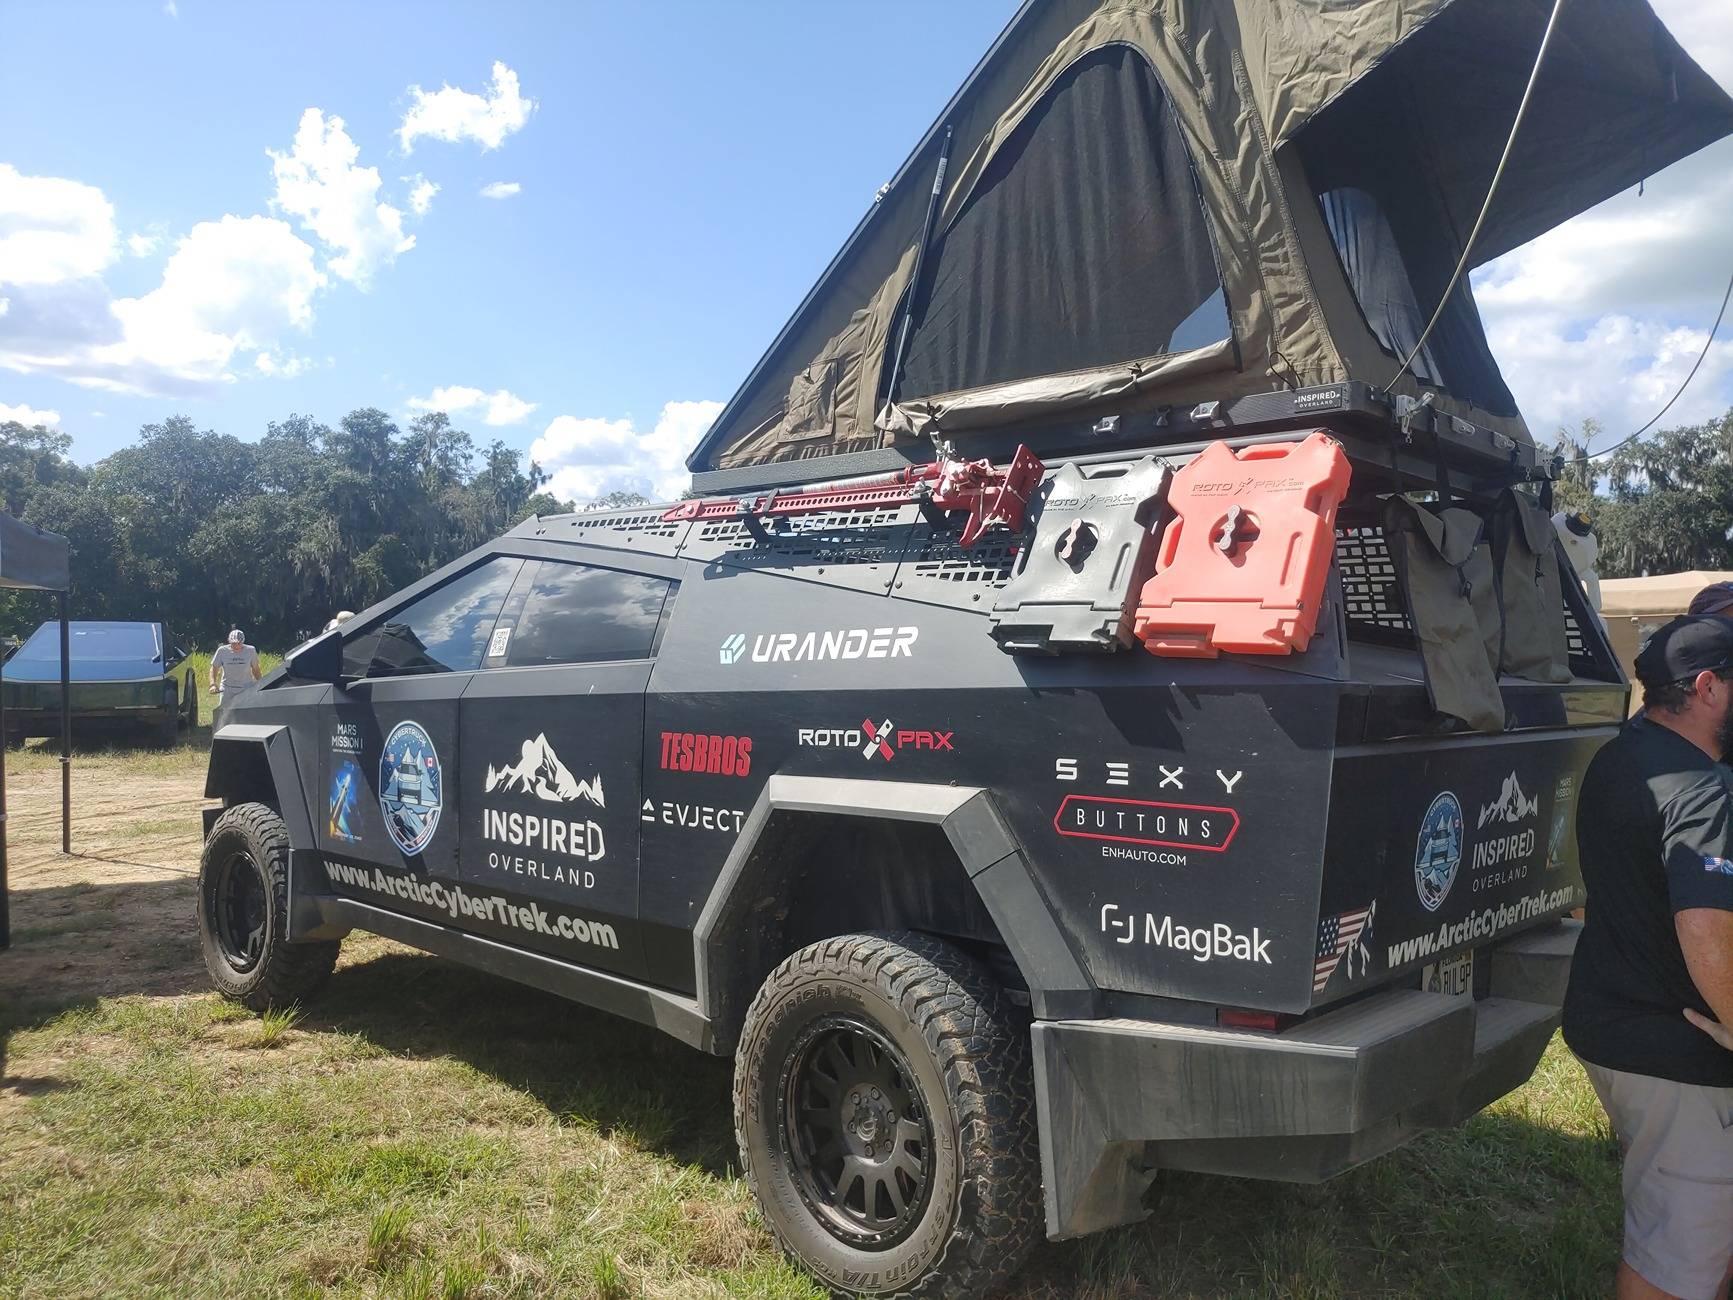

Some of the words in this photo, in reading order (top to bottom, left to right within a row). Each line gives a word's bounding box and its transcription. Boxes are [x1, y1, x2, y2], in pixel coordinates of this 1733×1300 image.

[1298, 390, 1336, 402] INSPIRED
[1299, 400, 1333, 408] OVERLAND
[751, 626, 919, 663] URANDER
[331, 735, 360, 749] MISSION
[337, 723, 357, 736] MARS
[391, 727, 427, 747] CYBERTRUCK
[660, 732, 752, 777] TESBROS
[662, 802, 744, 833] EVJECT
[1077, 808, 1210, 838] BUTTONS
[483, 808, 606, 862] INSPIRED
[1472, 828, 1535, 870] INSPIRED
[489, 852, 595, 889] OVERLAND
[1102, 846, 1187, 866] ENHAUTO.COM
[1472, 865, 1528, 893] OVERLAND
[324, 860, 620, 950] www.ArcticCyberTrek.com
[1144, 913, 1272, 965] MagBak
[1388, 884, 1574, 968] www.ArcticCyberTrek.com
